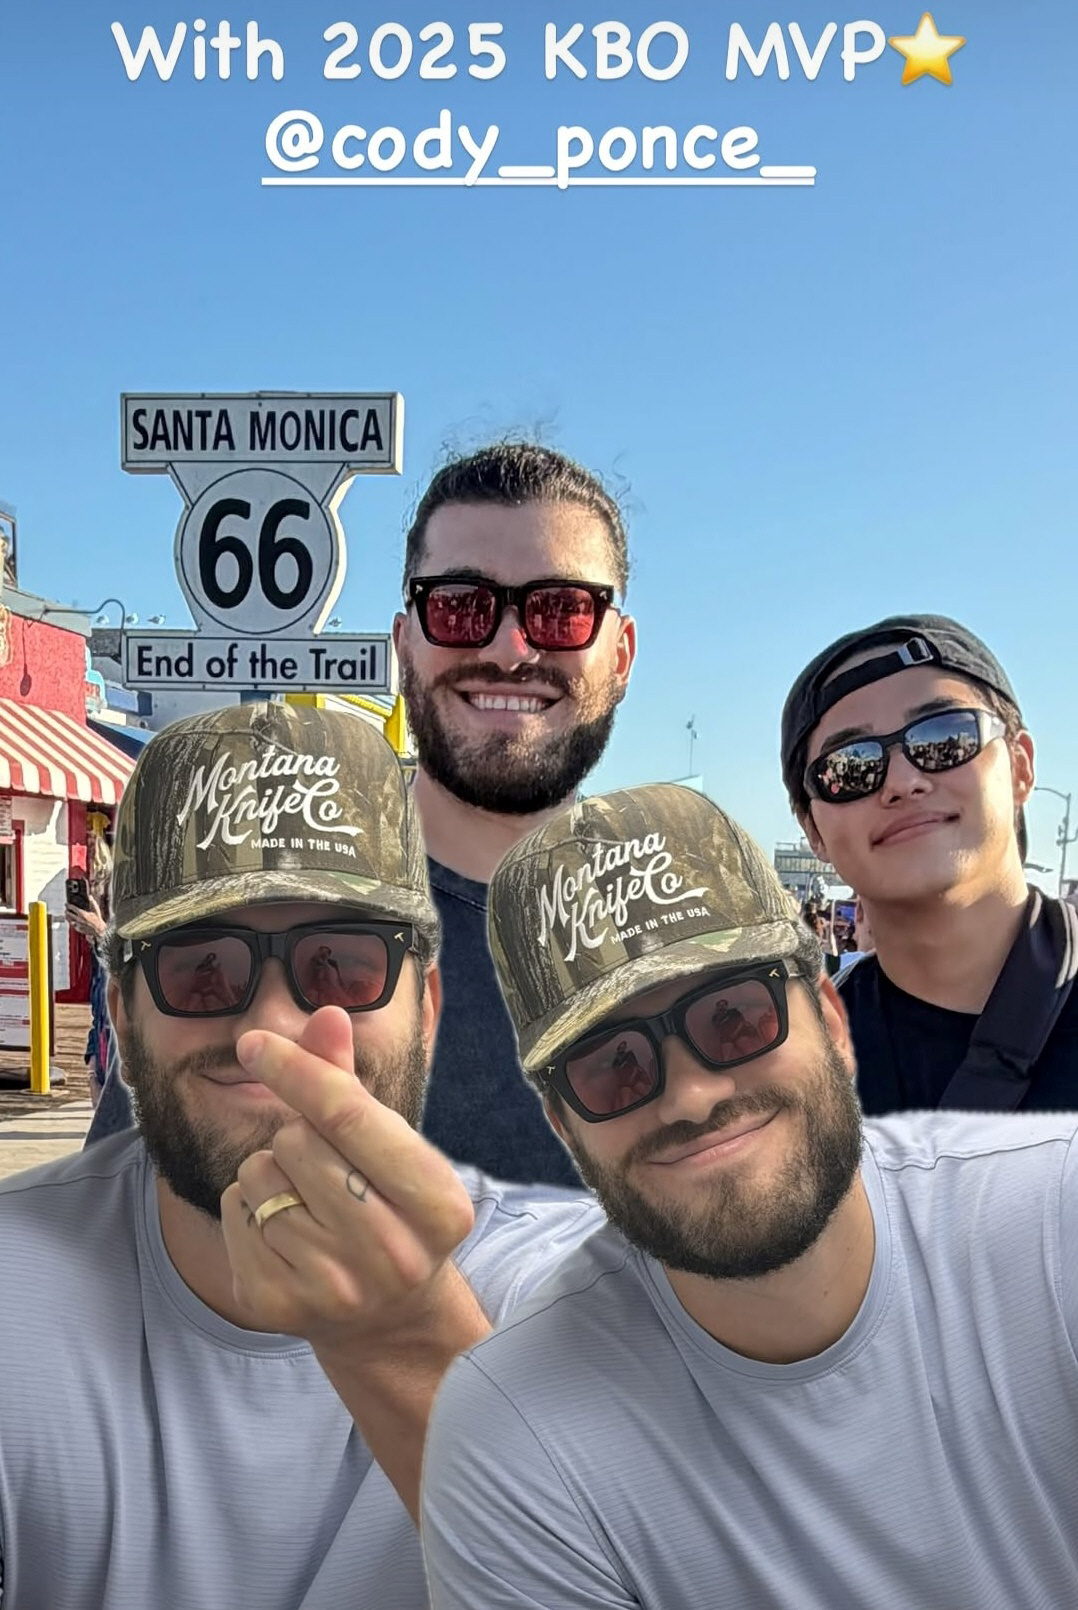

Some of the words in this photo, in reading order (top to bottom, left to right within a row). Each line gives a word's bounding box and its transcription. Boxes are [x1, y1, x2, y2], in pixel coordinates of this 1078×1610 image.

[132, 409, 235, 451] SANTA
[249, 409, 383, 452] MONICA
[199, 498, 313, 610] 66
[137, 643, 193, 678] End
[206, 644, 238, 679] of
[249, 644, 298, 680] the
[309, 645, 376, 681] Trail
[177, 745, 340, 825] Montana
[197, 785, 304, 850] Knife
[251, 838, 285, 849] MADE
[291, 839, 303, 849] IN
[308, 839, 330, 851] THE
[335, 844, 357, 858] USA
[537, 832, 666, 946] Montana
[564, 876, 646, 962] Knife
[610, 923, 642, 944] MADE
[645, 919, 659, 931] IN
[661, 911, 684, 925] THE
[687, 907, 710, 919] USA
